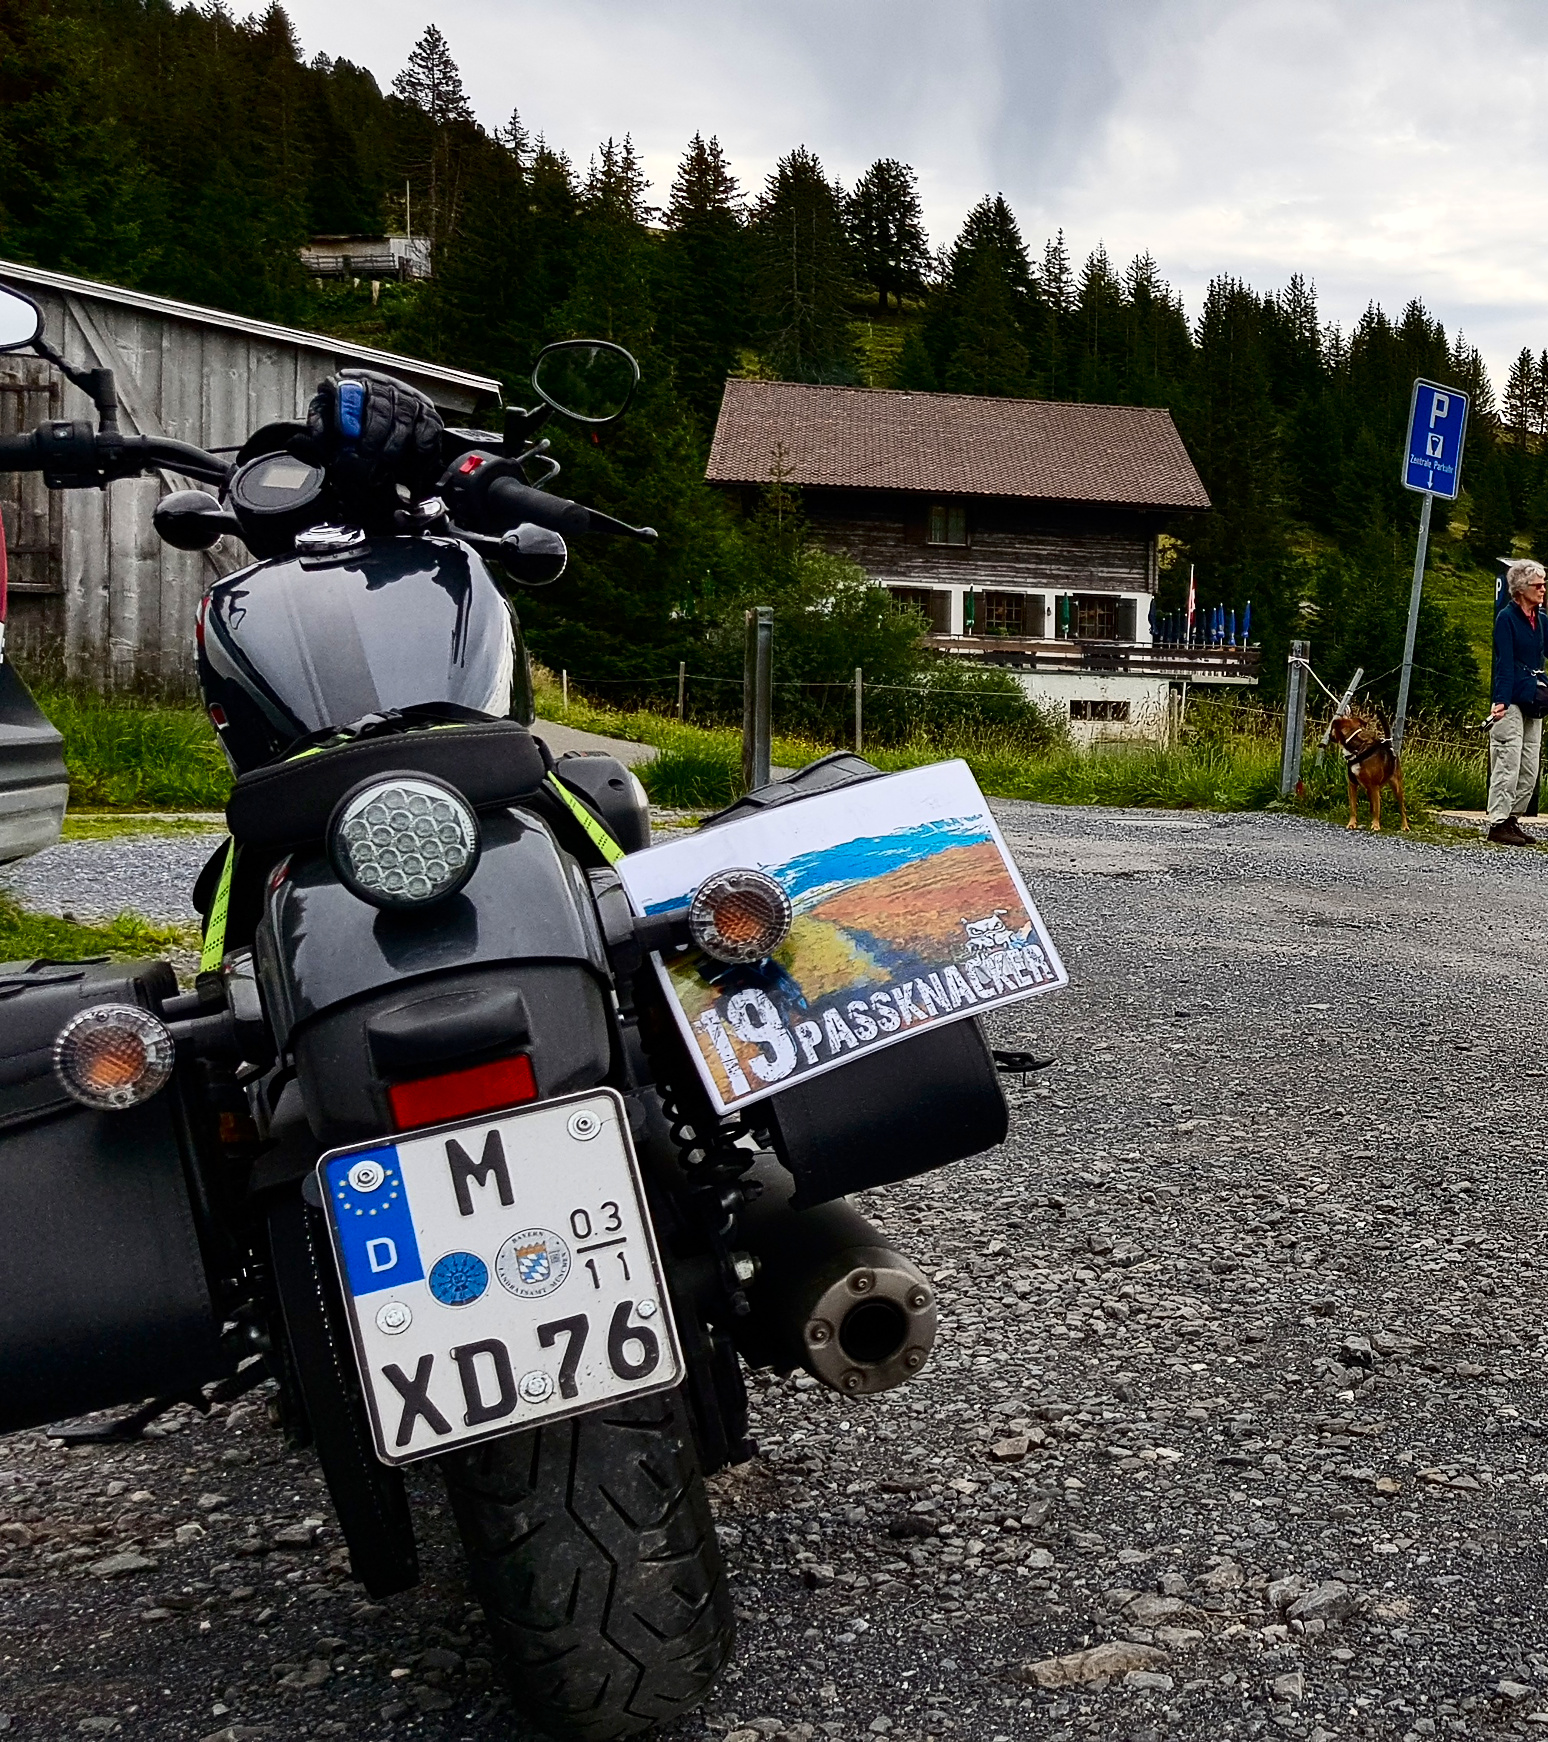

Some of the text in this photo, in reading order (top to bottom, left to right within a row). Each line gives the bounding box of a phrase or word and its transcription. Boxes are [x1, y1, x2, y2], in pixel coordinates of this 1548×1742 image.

[1430, 391, 1450, 429] P
[1410, 453, 1454, 474] Zentrale Parkuhr
[1495, 577, 1502, 601] P
[694, 944, 1055, 1096] 19 PASSKNACKER
[444, 1128, 515, 1217] M
[511, 1231, 544, 1244] BAYERN
[569, 1201, 623, 1240] 03
[365, 1236, 399, 1274] D
[584, 1250, 631, 1290] 11
[498, 1267, 547, 1296] LANDRATSAMT
[381, 1300, 661, 1448] XD 76
